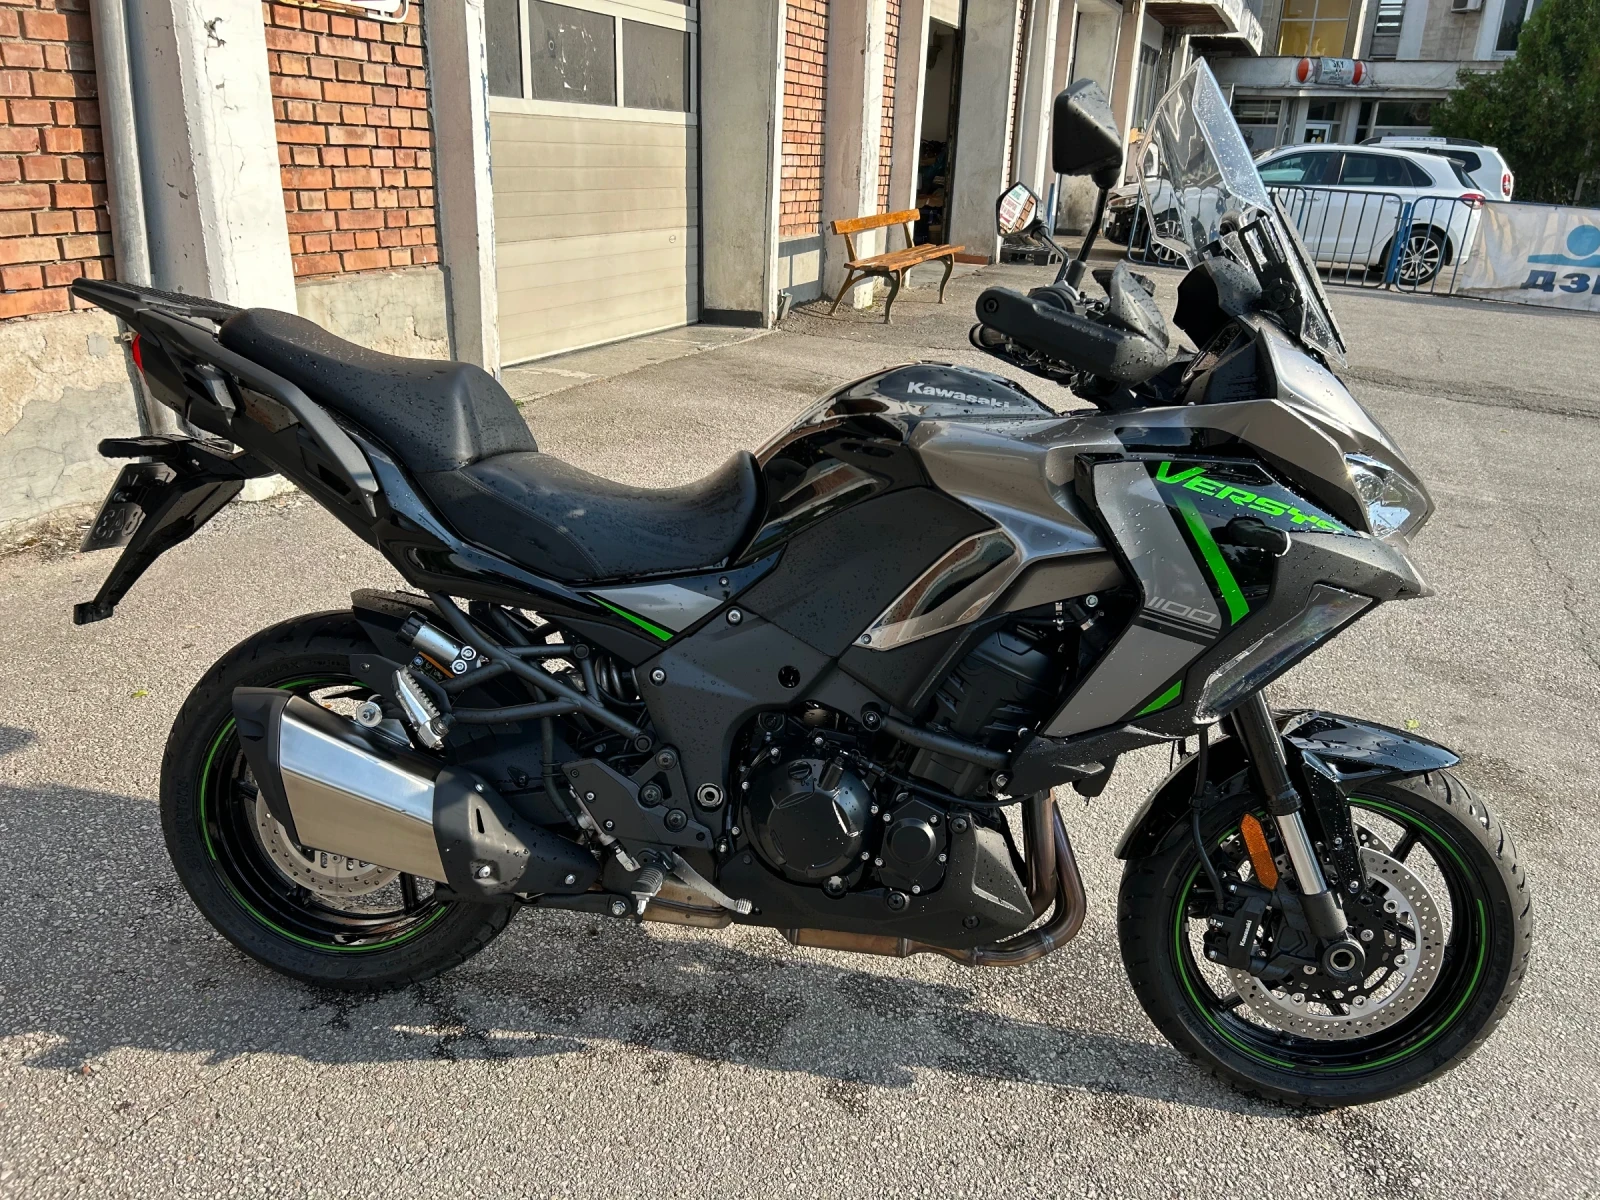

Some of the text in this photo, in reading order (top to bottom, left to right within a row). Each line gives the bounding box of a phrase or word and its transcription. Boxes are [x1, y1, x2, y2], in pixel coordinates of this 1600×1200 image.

[1519, 269, 1600, 295] ДЗ
[906, 381, 1010, 409] Kawasaki
[1147, 596, 1218, 624] 1100
